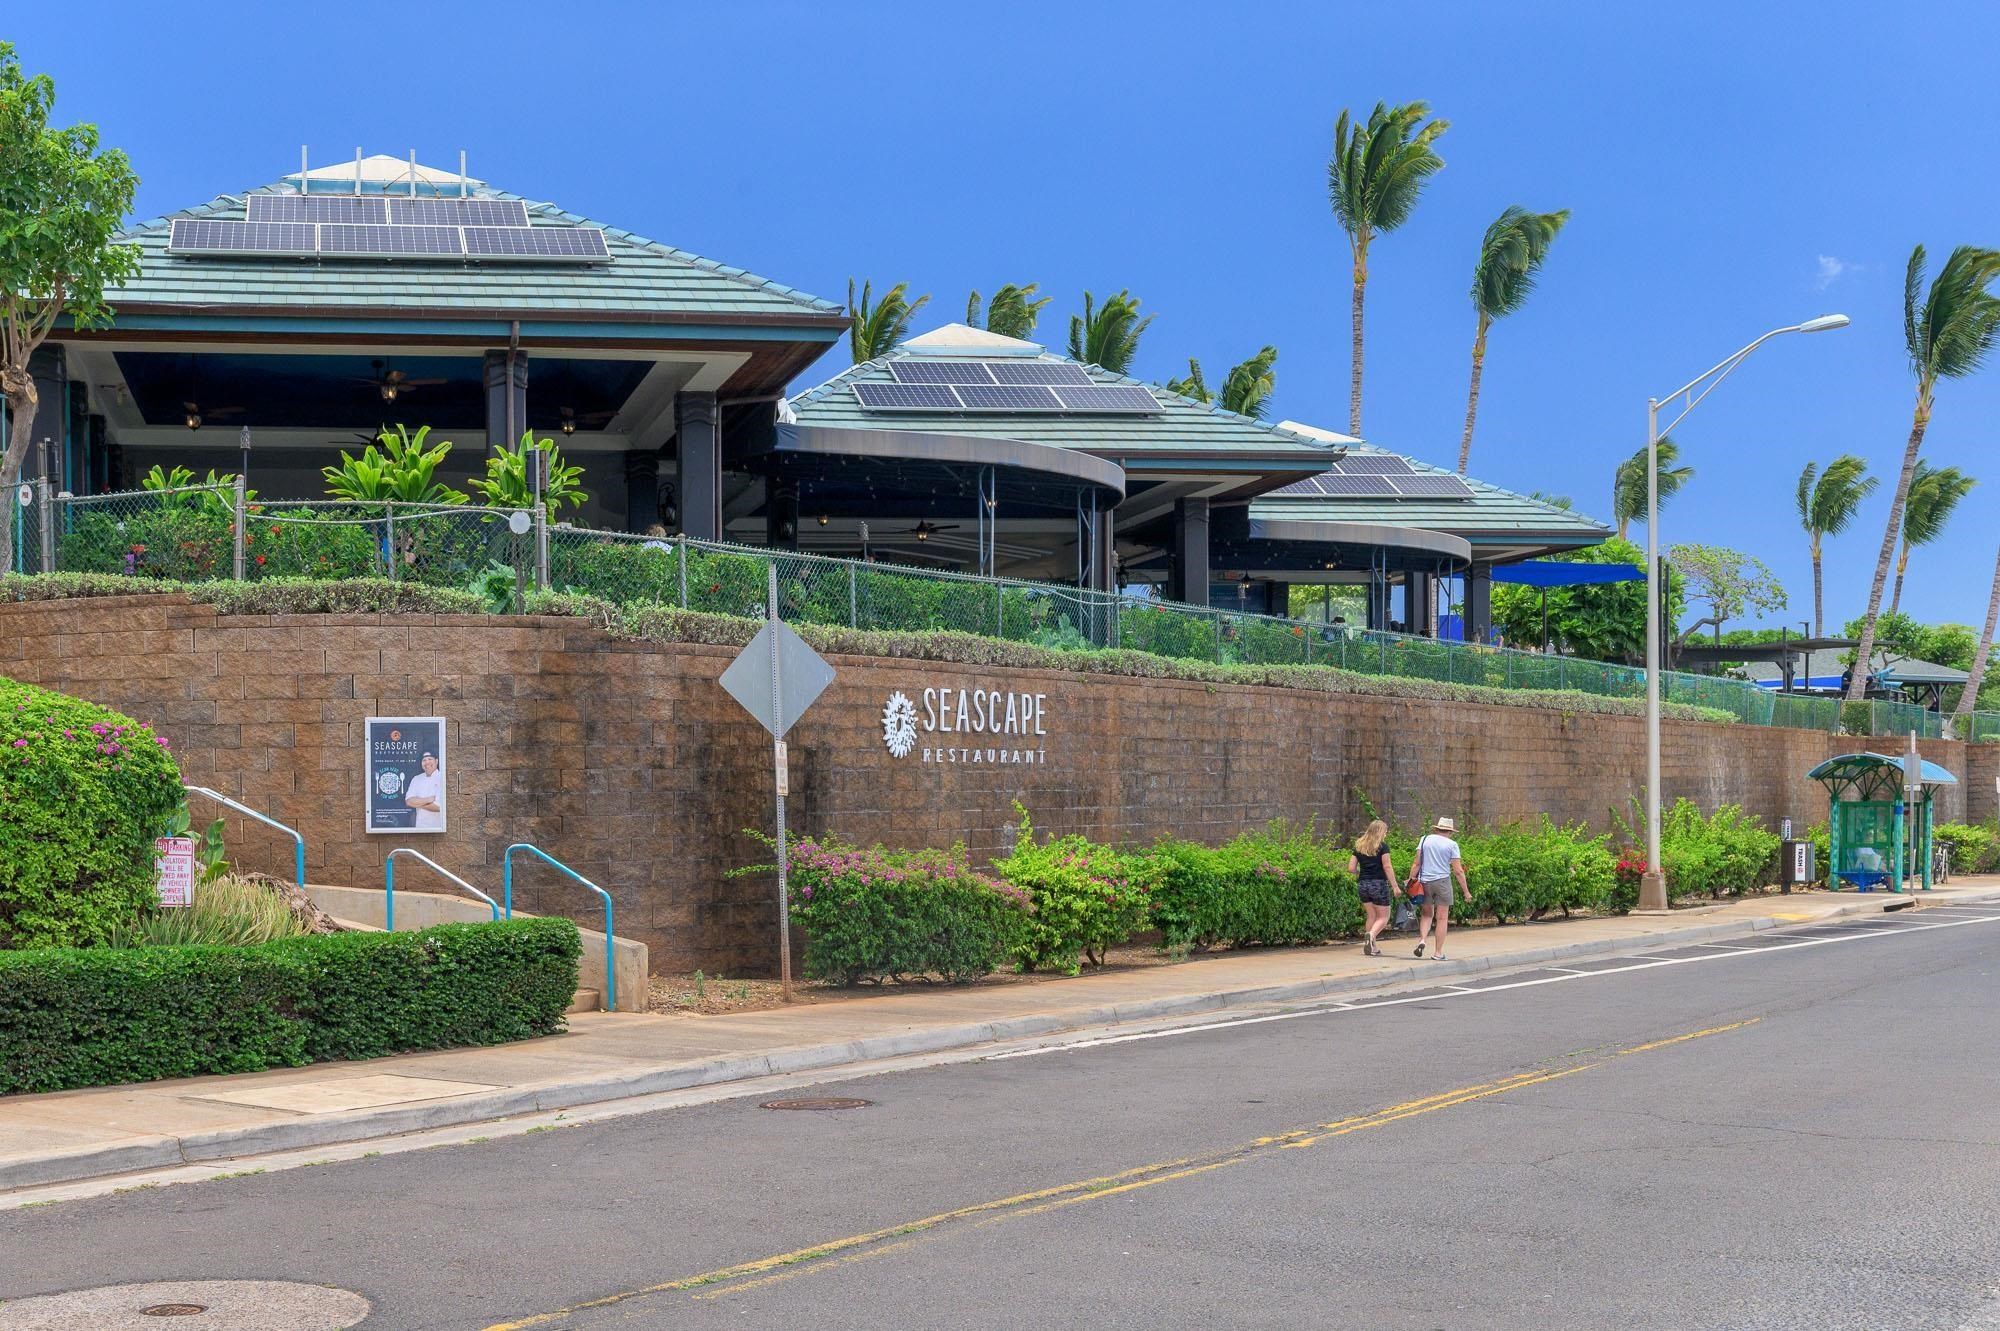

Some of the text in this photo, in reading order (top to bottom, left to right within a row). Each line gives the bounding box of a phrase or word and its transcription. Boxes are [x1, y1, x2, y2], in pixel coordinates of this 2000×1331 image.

[922, 687, 1047, 735] SEASCAPE
[374, 741, 418, 750] SEASCAPE
[922, 748, 1046, 764] RESTAURANT
[157, 841, 191, 852] NO PARKING
[167, 879, 188, 887] VEHICLE
